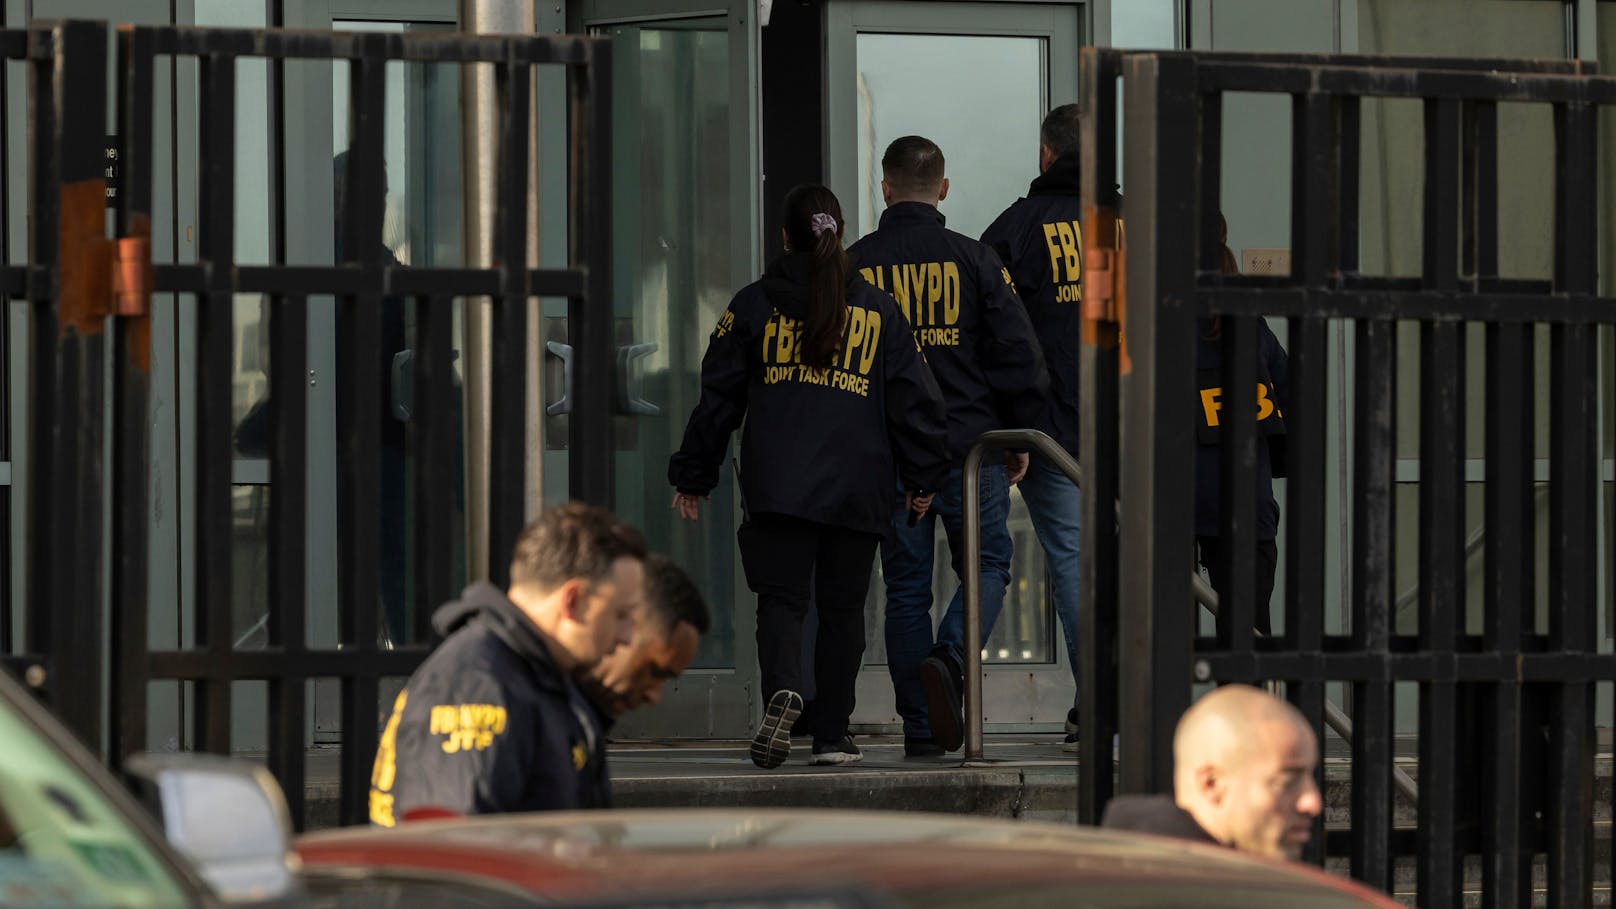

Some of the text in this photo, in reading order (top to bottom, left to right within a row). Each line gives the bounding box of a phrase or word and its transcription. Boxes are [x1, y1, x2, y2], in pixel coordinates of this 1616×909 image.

[921, 327, 960, 346] FORCE
[798, 364, 831, 387] TASK
[831, 369, 870, 398] FORCE
